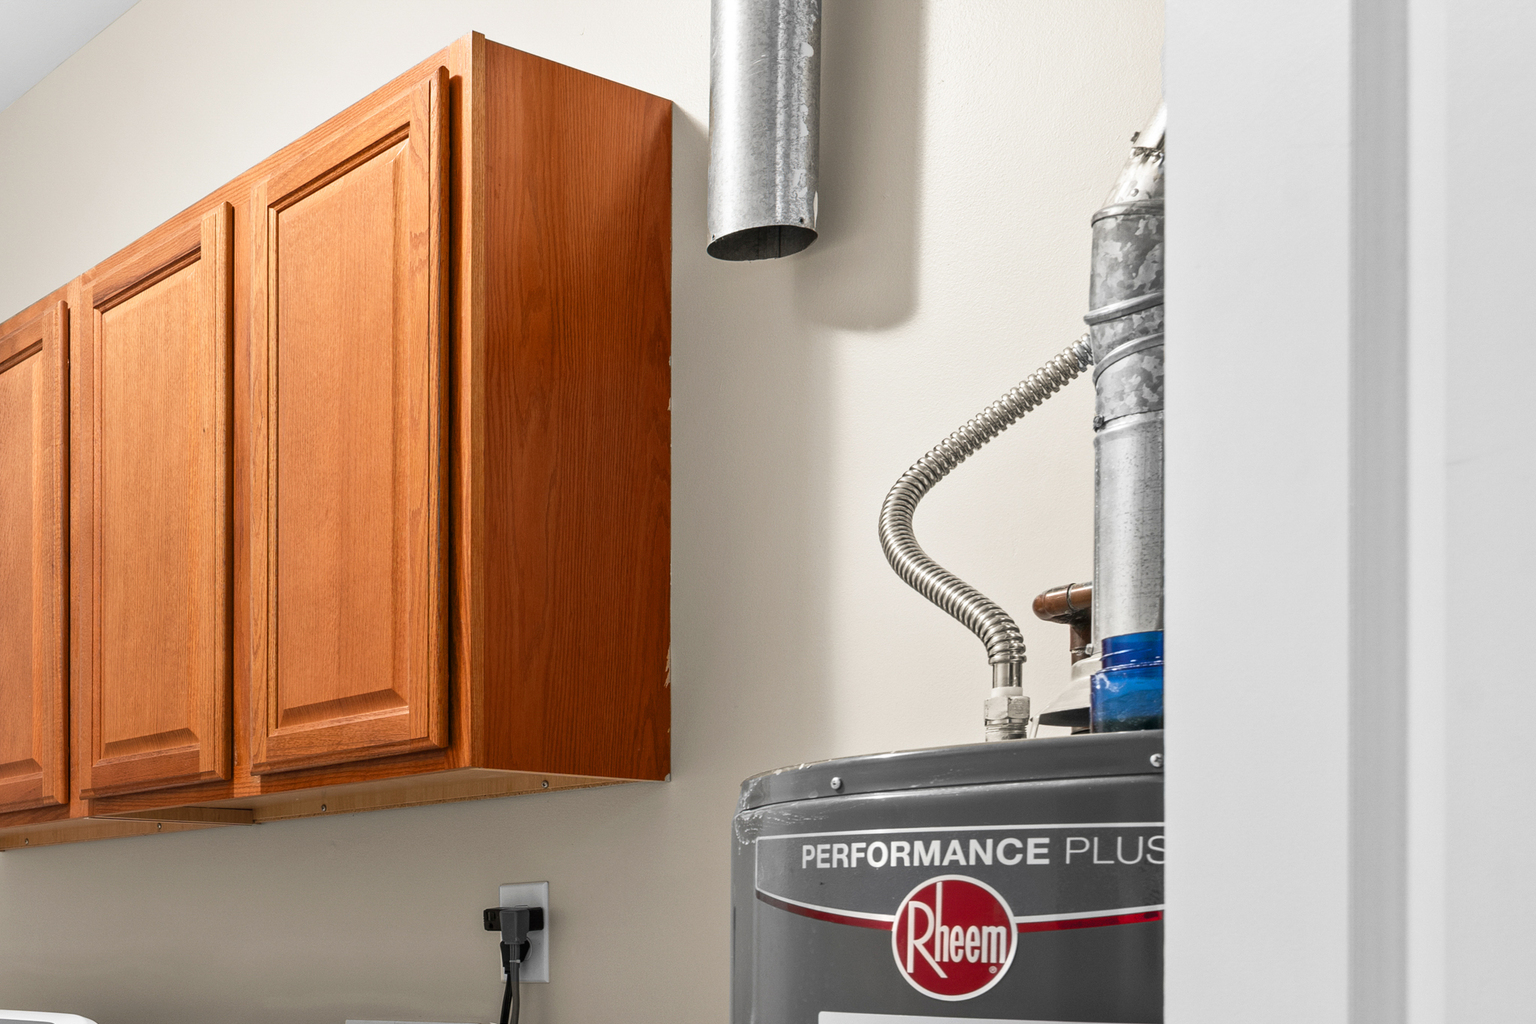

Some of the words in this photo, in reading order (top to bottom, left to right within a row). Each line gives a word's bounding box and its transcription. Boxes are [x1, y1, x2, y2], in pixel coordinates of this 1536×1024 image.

[802, 837, 1050, 869] PERFORMANCE
[1066, 836, 1164, 865] PLUS
[907, 882, 1007, 978] Rheem
